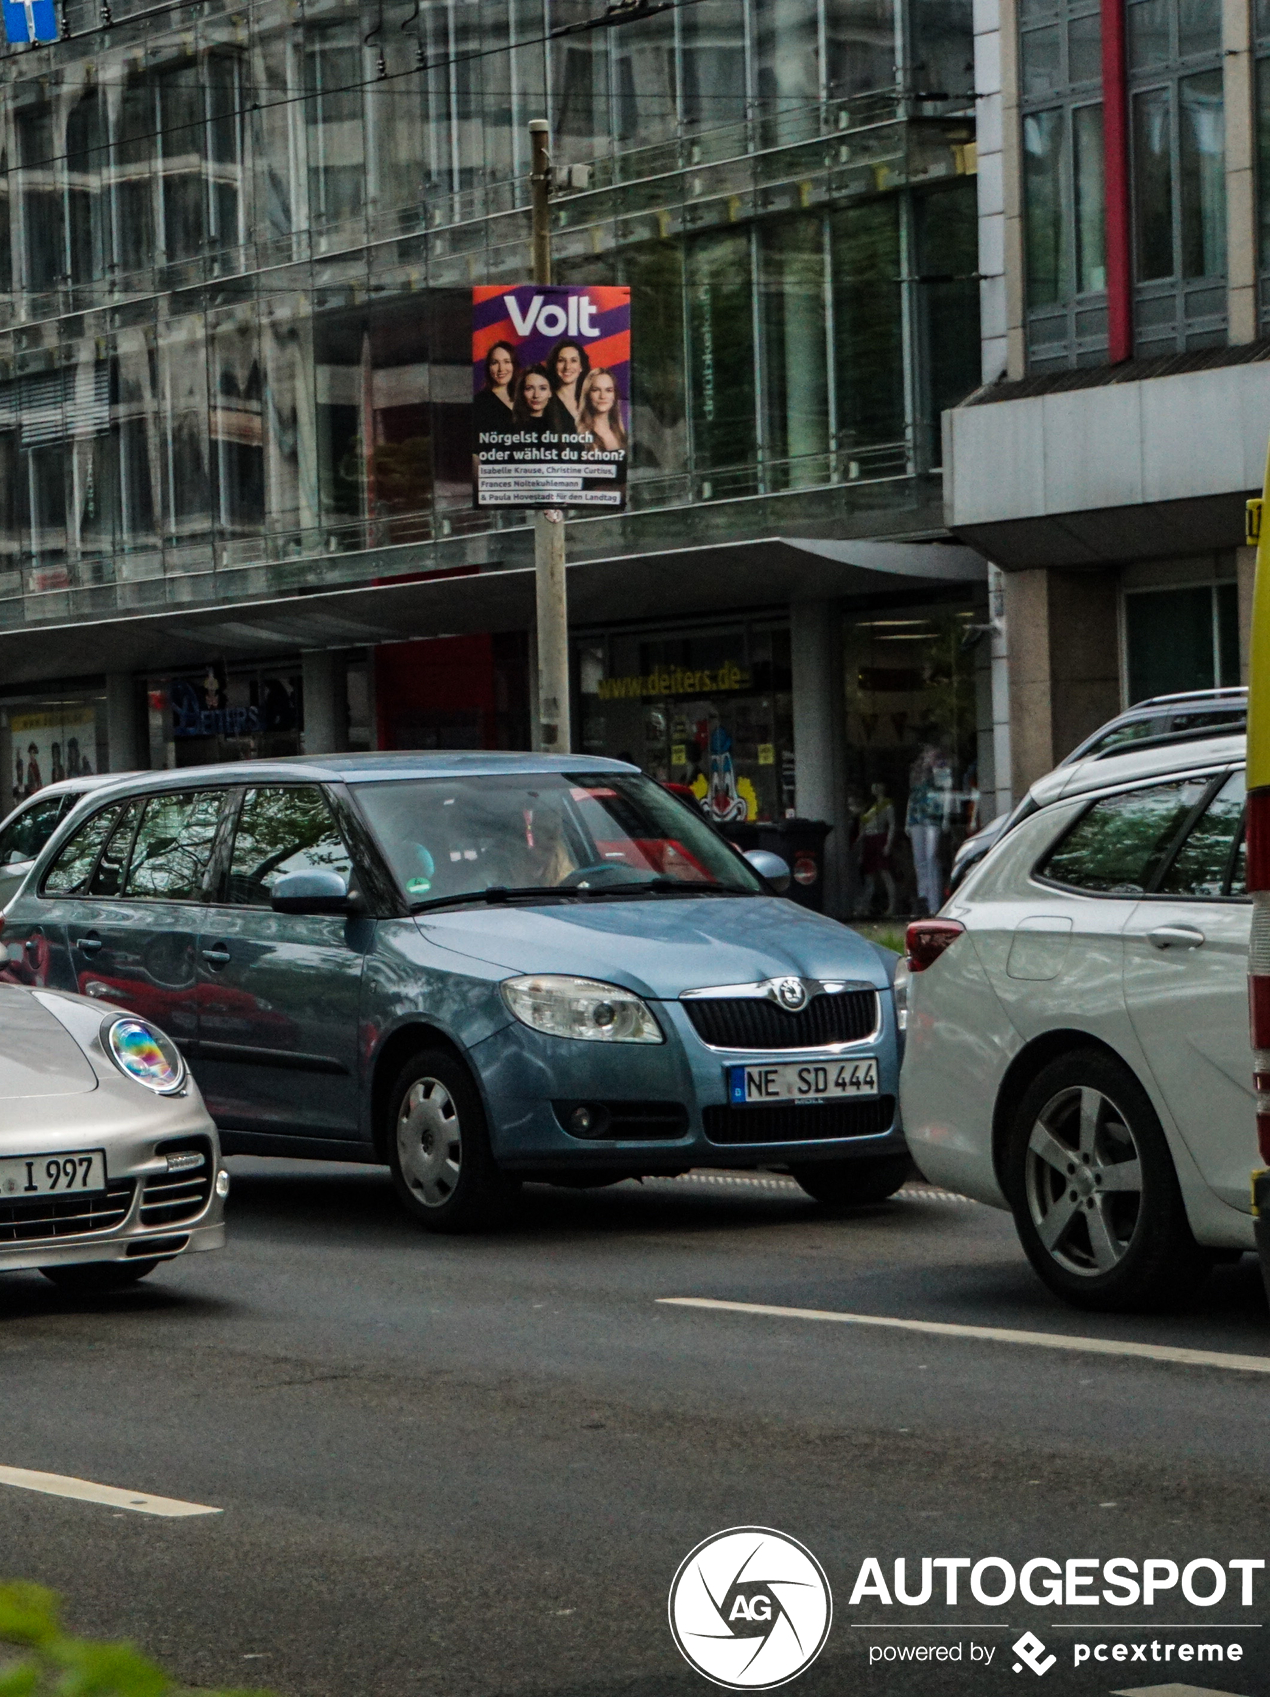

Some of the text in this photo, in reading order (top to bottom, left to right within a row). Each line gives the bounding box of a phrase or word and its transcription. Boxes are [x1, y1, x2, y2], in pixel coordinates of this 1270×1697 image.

[503, 295, 601, 337] Volt
[479, 431, 593, 446] Nörgelst du noch
[479, 448, 625, 461] oder wählst du schon?
[480, 466, 614, 476] Isabelle Krause, Christine Curtius,
[480, 480, 511, 488] Frances
[489, 493, 511, 501] Paula
[513, 492, 555, 501] Hovestadt
[585, 493, 618, 503] Landtag
[597, 661, 741, 700] www.deiters.de
[746, 1069, 779, 1097] NE
[797, 1066, 828, 1094] SD
[834, 1063, 875, 1092] 444
[24, 1161, 38, 1192] I
[45, 1156, 93, 1190] 997
